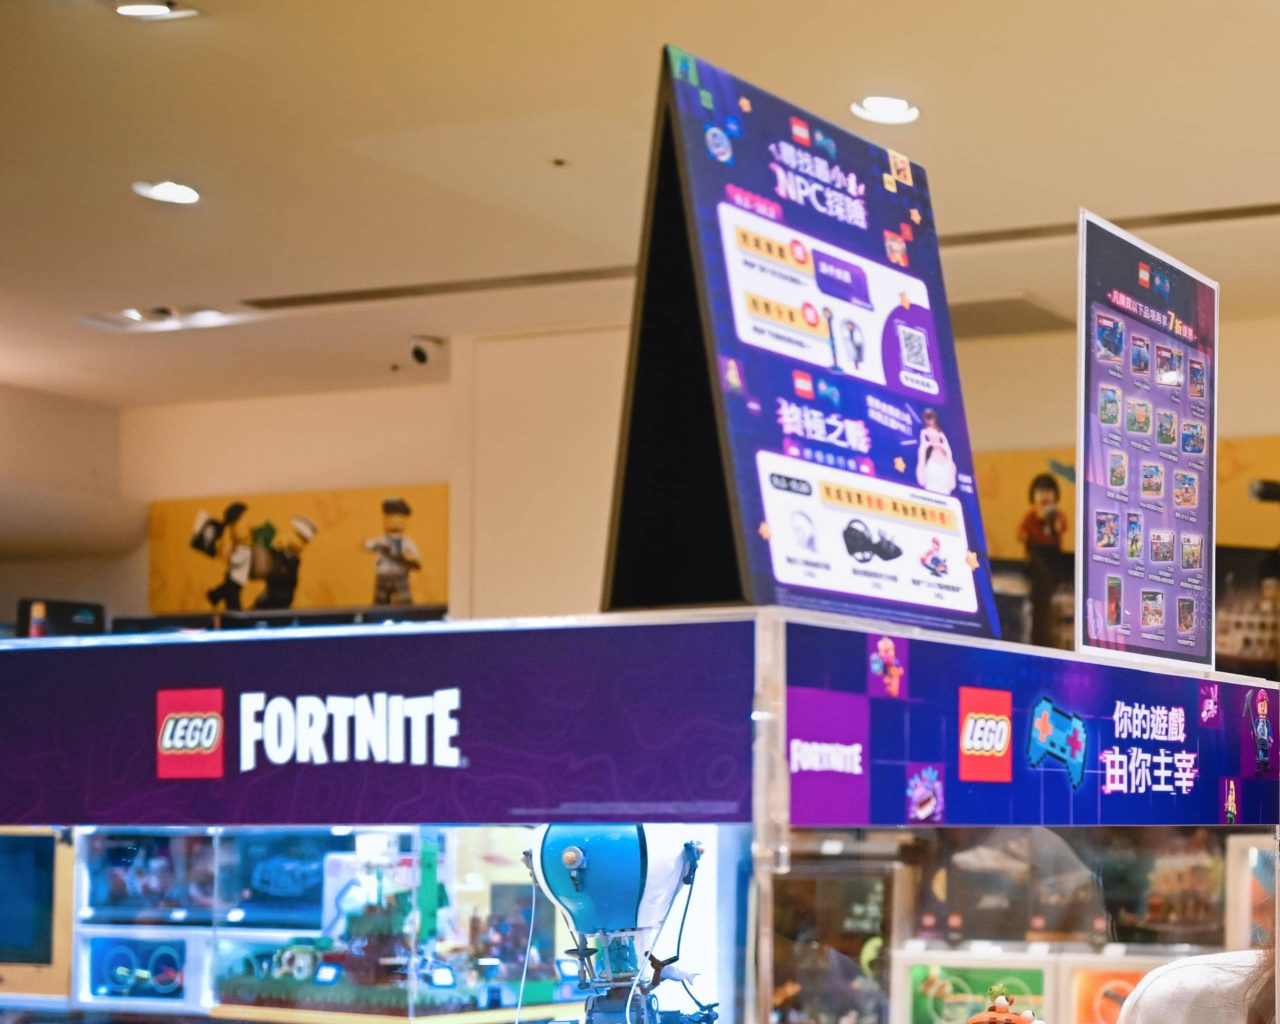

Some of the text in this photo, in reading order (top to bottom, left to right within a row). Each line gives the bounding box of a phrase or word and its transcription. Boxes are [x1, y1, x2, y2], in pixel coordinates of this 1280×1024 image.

[160, 688, 460, 771] LEGO FORTNITE
[963, 714, 1010, 754] LEGO
[1112, 700, 1187, 743] 你的遊戲
[1102, 746, 1196, 795] 由你主宰
